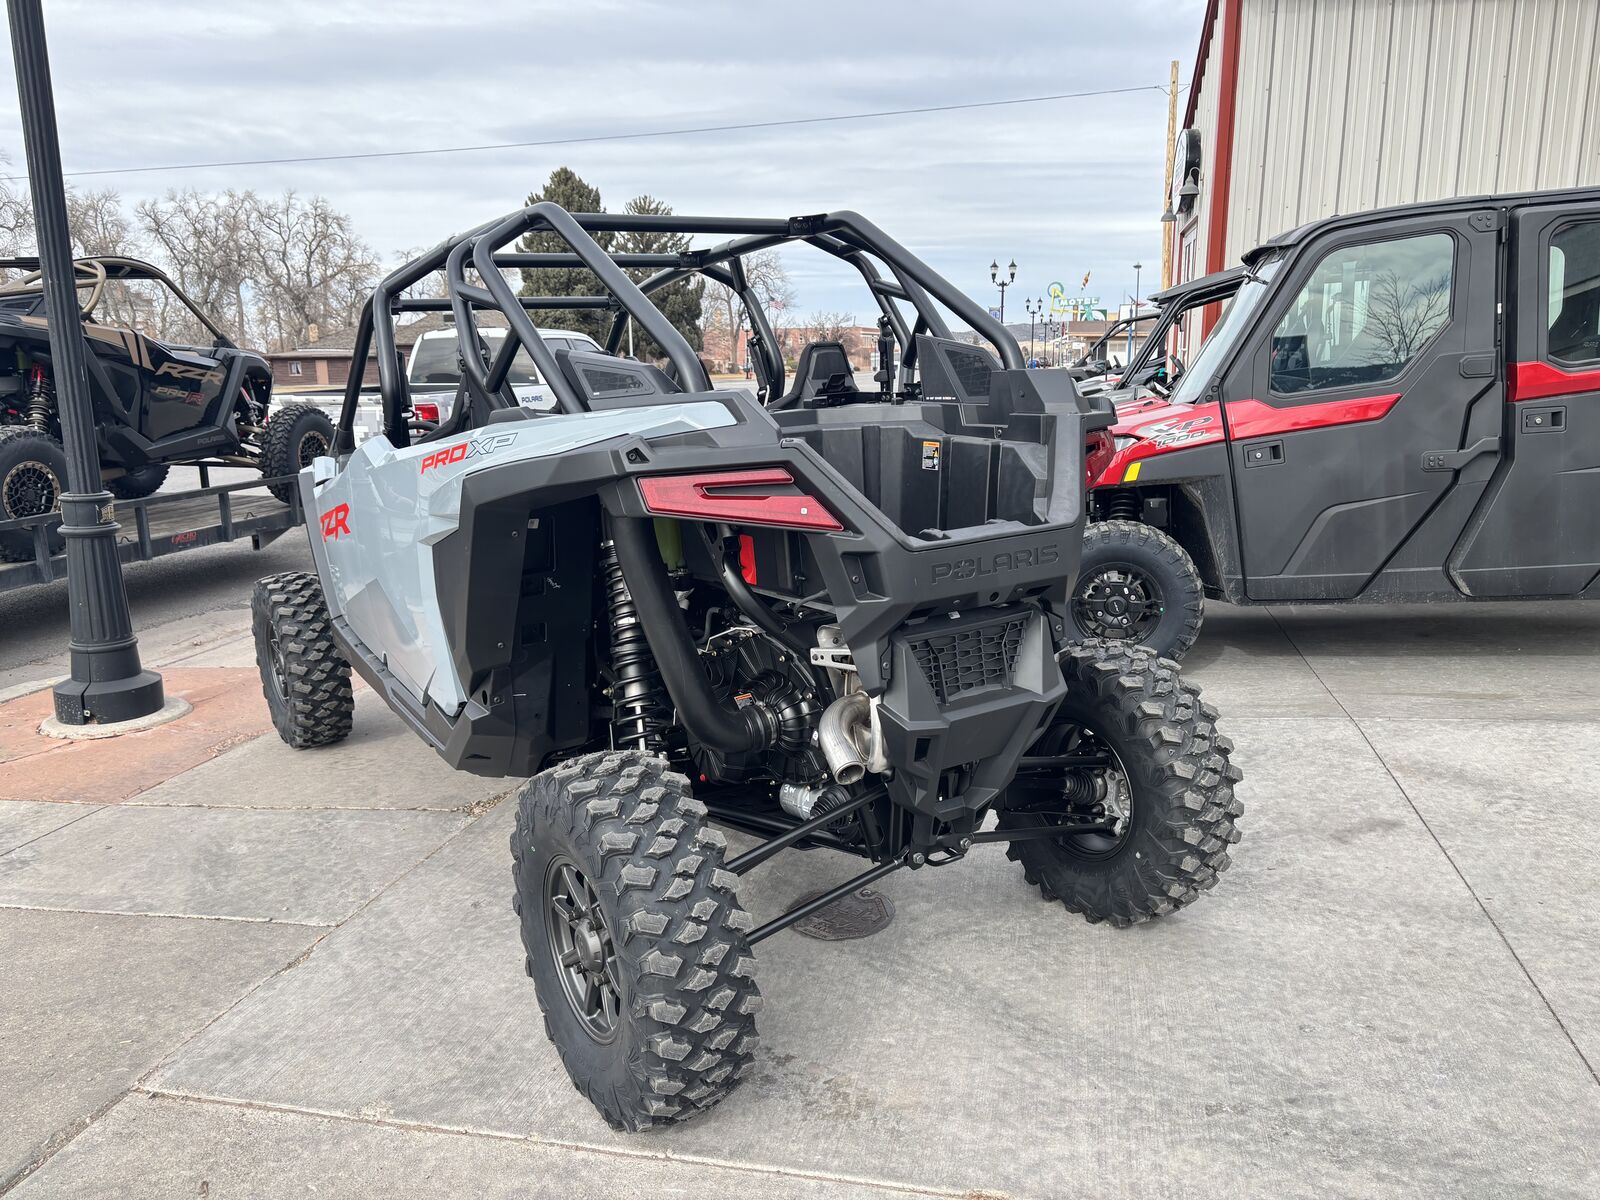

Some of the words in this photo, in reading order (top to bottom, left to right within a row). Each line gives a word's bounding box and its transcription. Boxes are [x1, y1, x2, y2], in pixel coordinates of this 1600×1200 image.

[1060, 297, 1100, 306] MOTEL
[155, 361, 225, 385] RZR
[155, 386, 189, 398] PRO
[521, 395, 543, 404] POLARIS
[1156, 430, 1206, 448] 1000
[931, 544, 1060, 585] POLARIS
